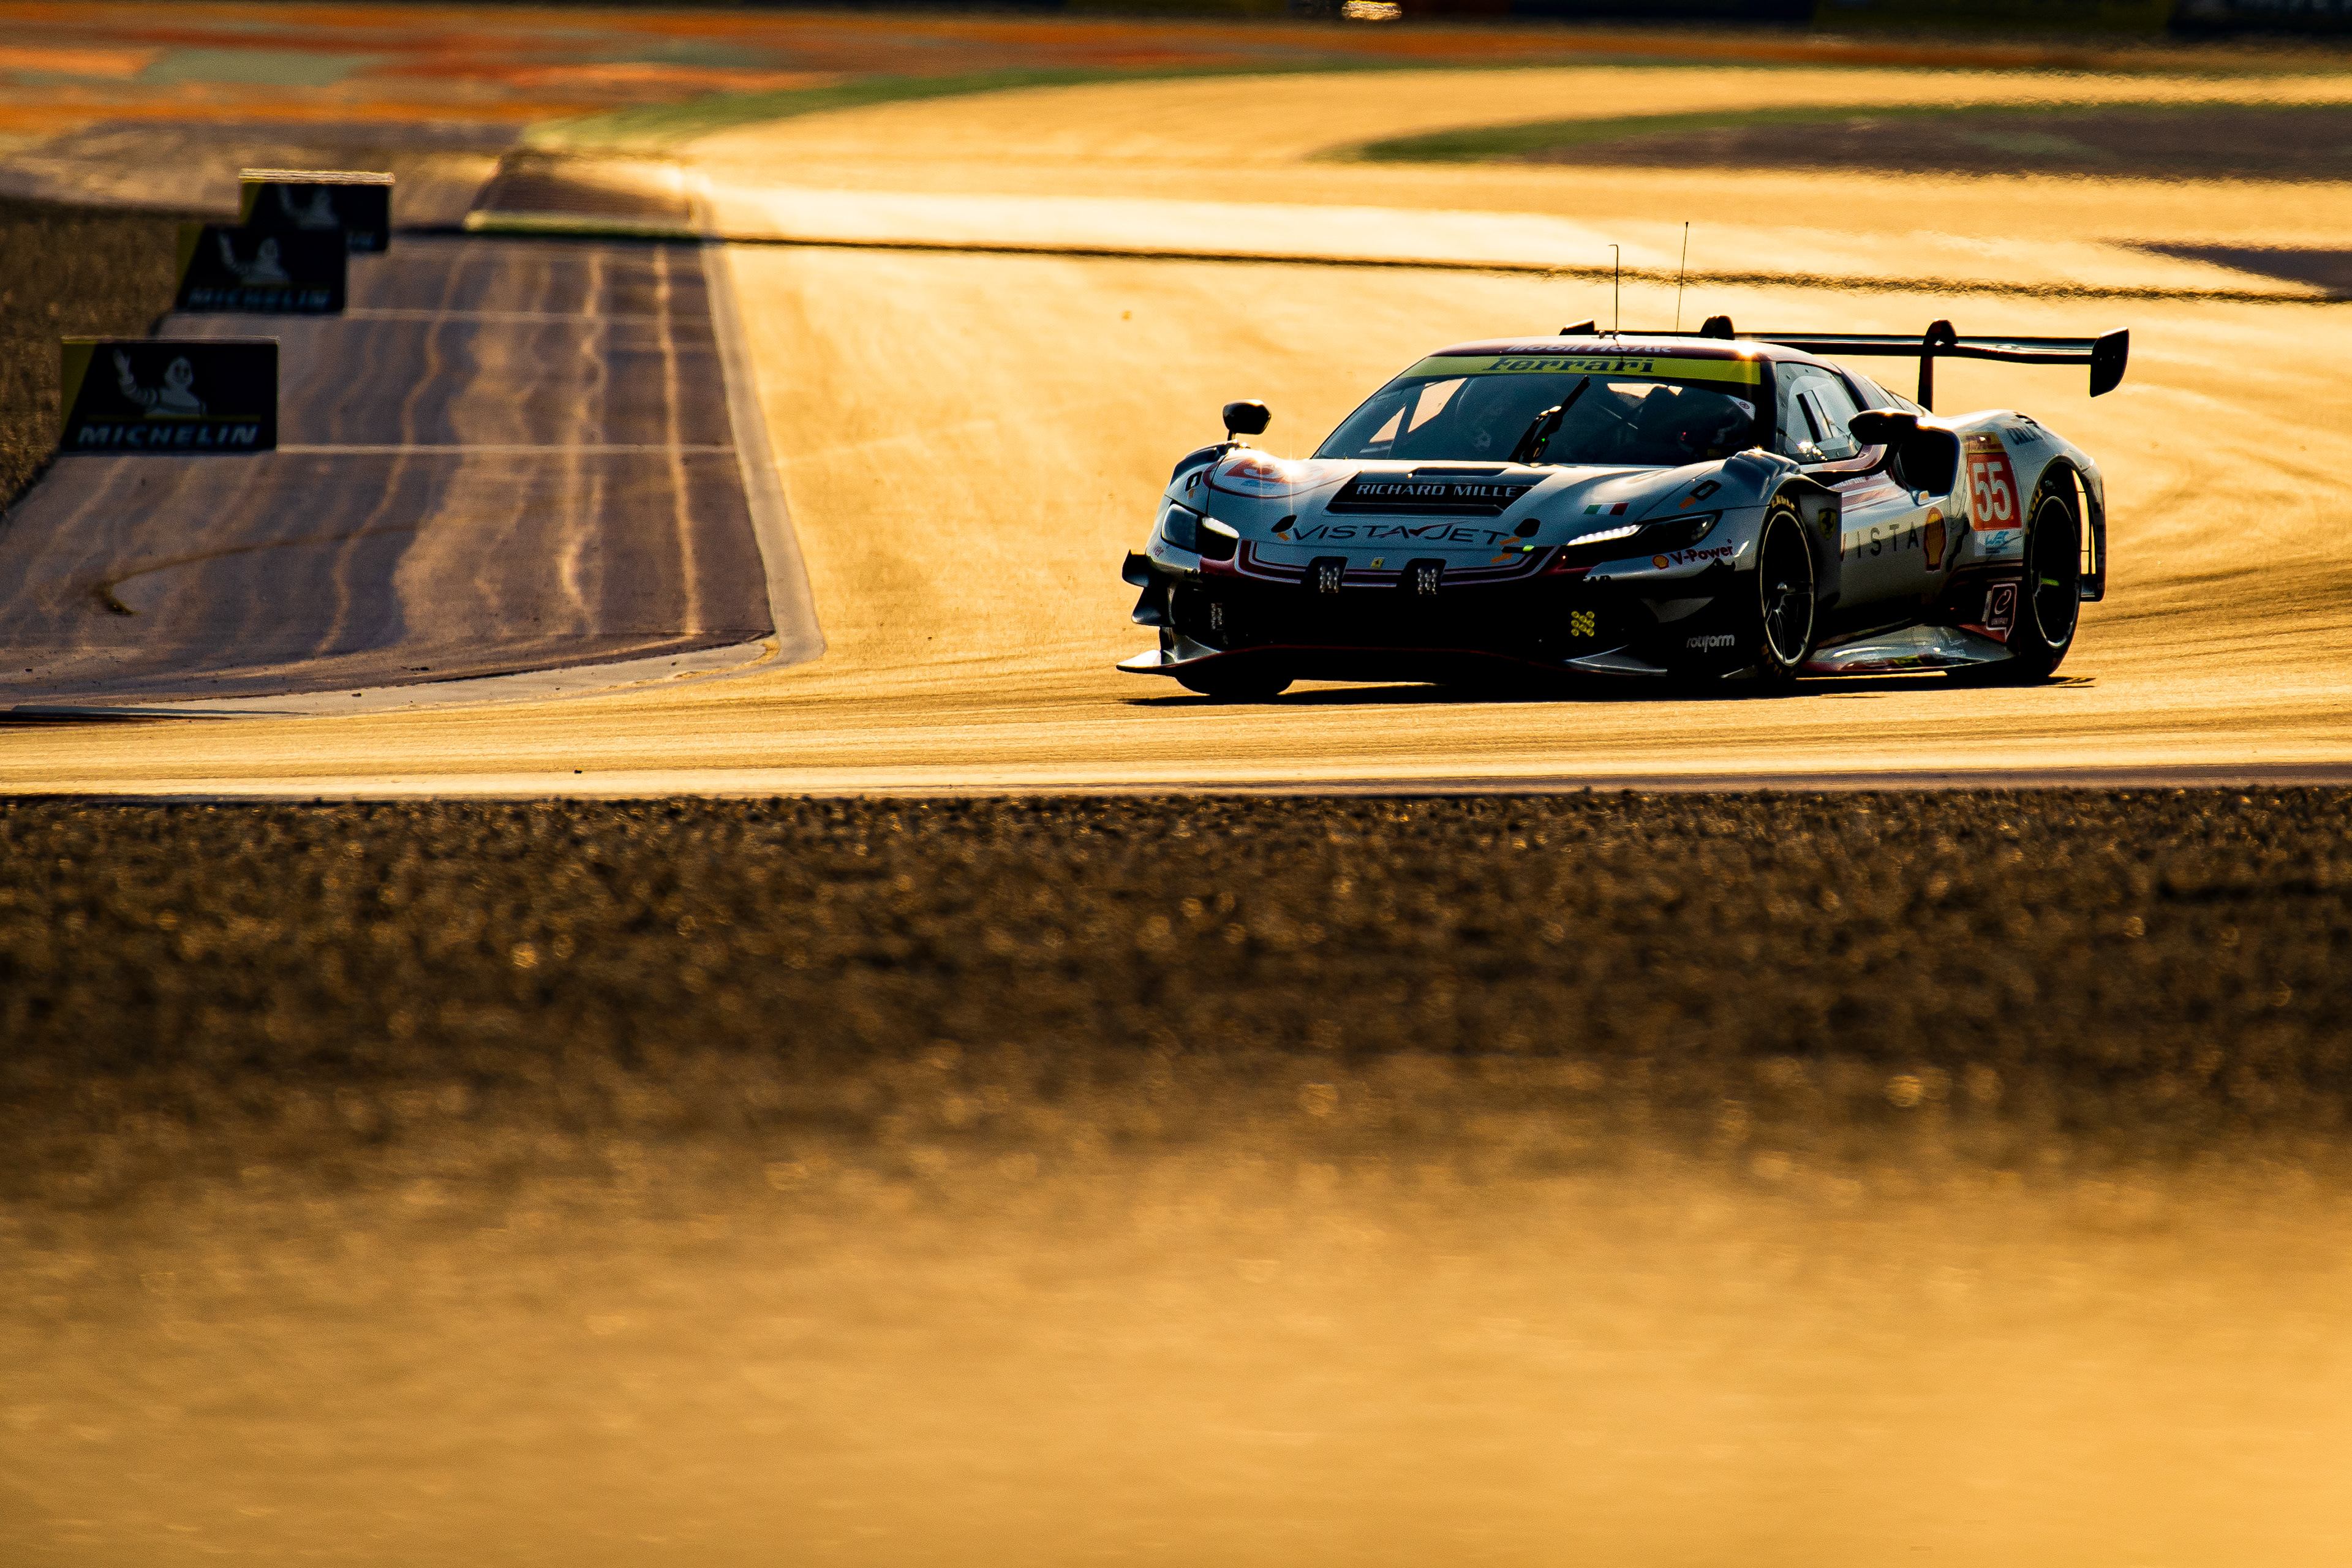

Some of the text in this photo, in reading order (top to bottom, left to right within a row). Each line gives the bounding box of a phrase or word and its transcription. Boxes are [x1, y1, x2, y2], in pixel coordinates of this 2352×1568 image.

[1483, 356, 1654, 373] Ferrari
[77, 424, 258, 447] MICHELIN
[1356, 484, 1517, 497] RICHARD MILLE
[1973, 462, 2012, 521] 55
[1670, 545, 1733, 566] V-Power
[1686, 634, 1735, 653] rotiform
